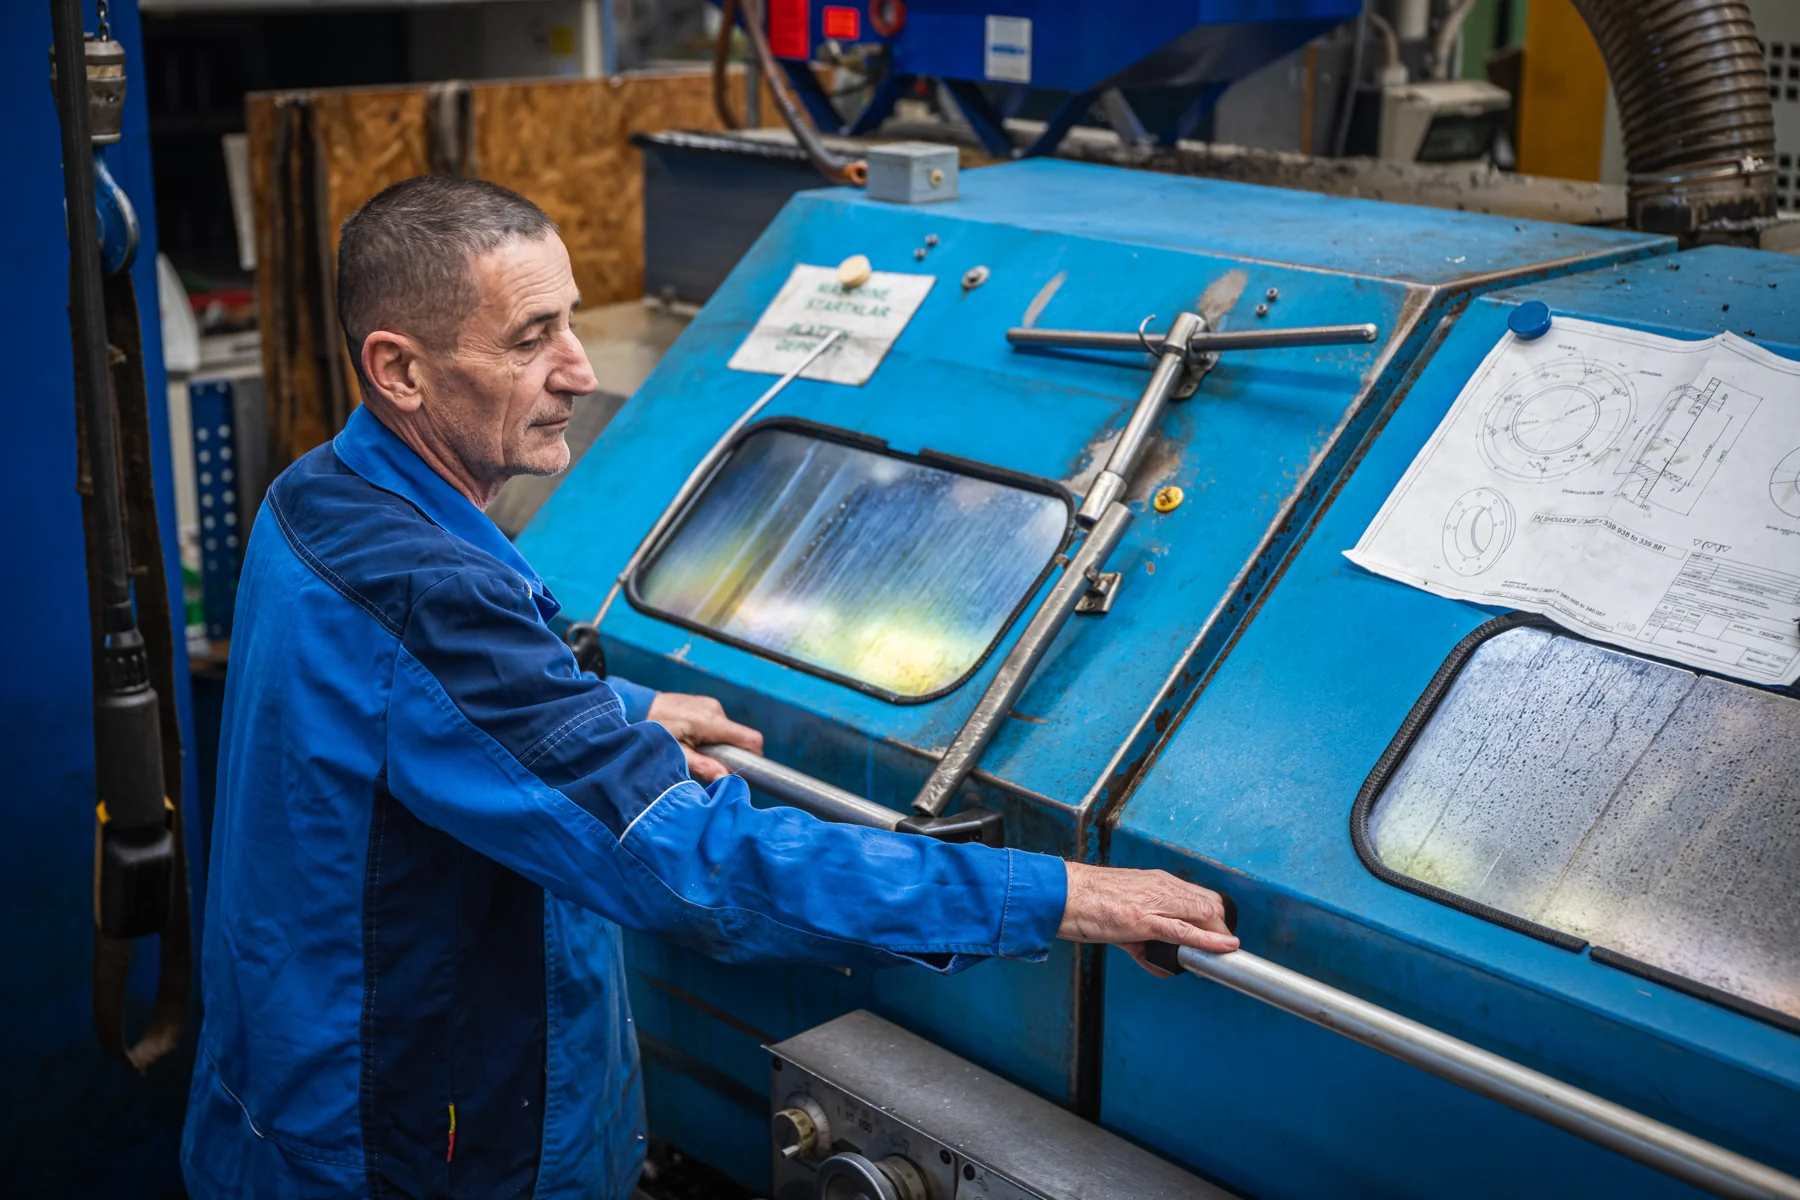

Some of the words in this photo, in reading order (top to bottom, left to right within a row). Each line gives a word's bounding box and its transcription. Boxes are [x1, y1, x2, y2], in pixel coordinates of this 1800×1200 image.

[805, 299, 891, 317] STARTKLAR
[1543, 516, 1577, 524] SHOULDER
[1603, 519, 1631, 538] 339.938
[1630, 534, 1638, 542] to
[1638, 538, 1667, 552] 339.881
